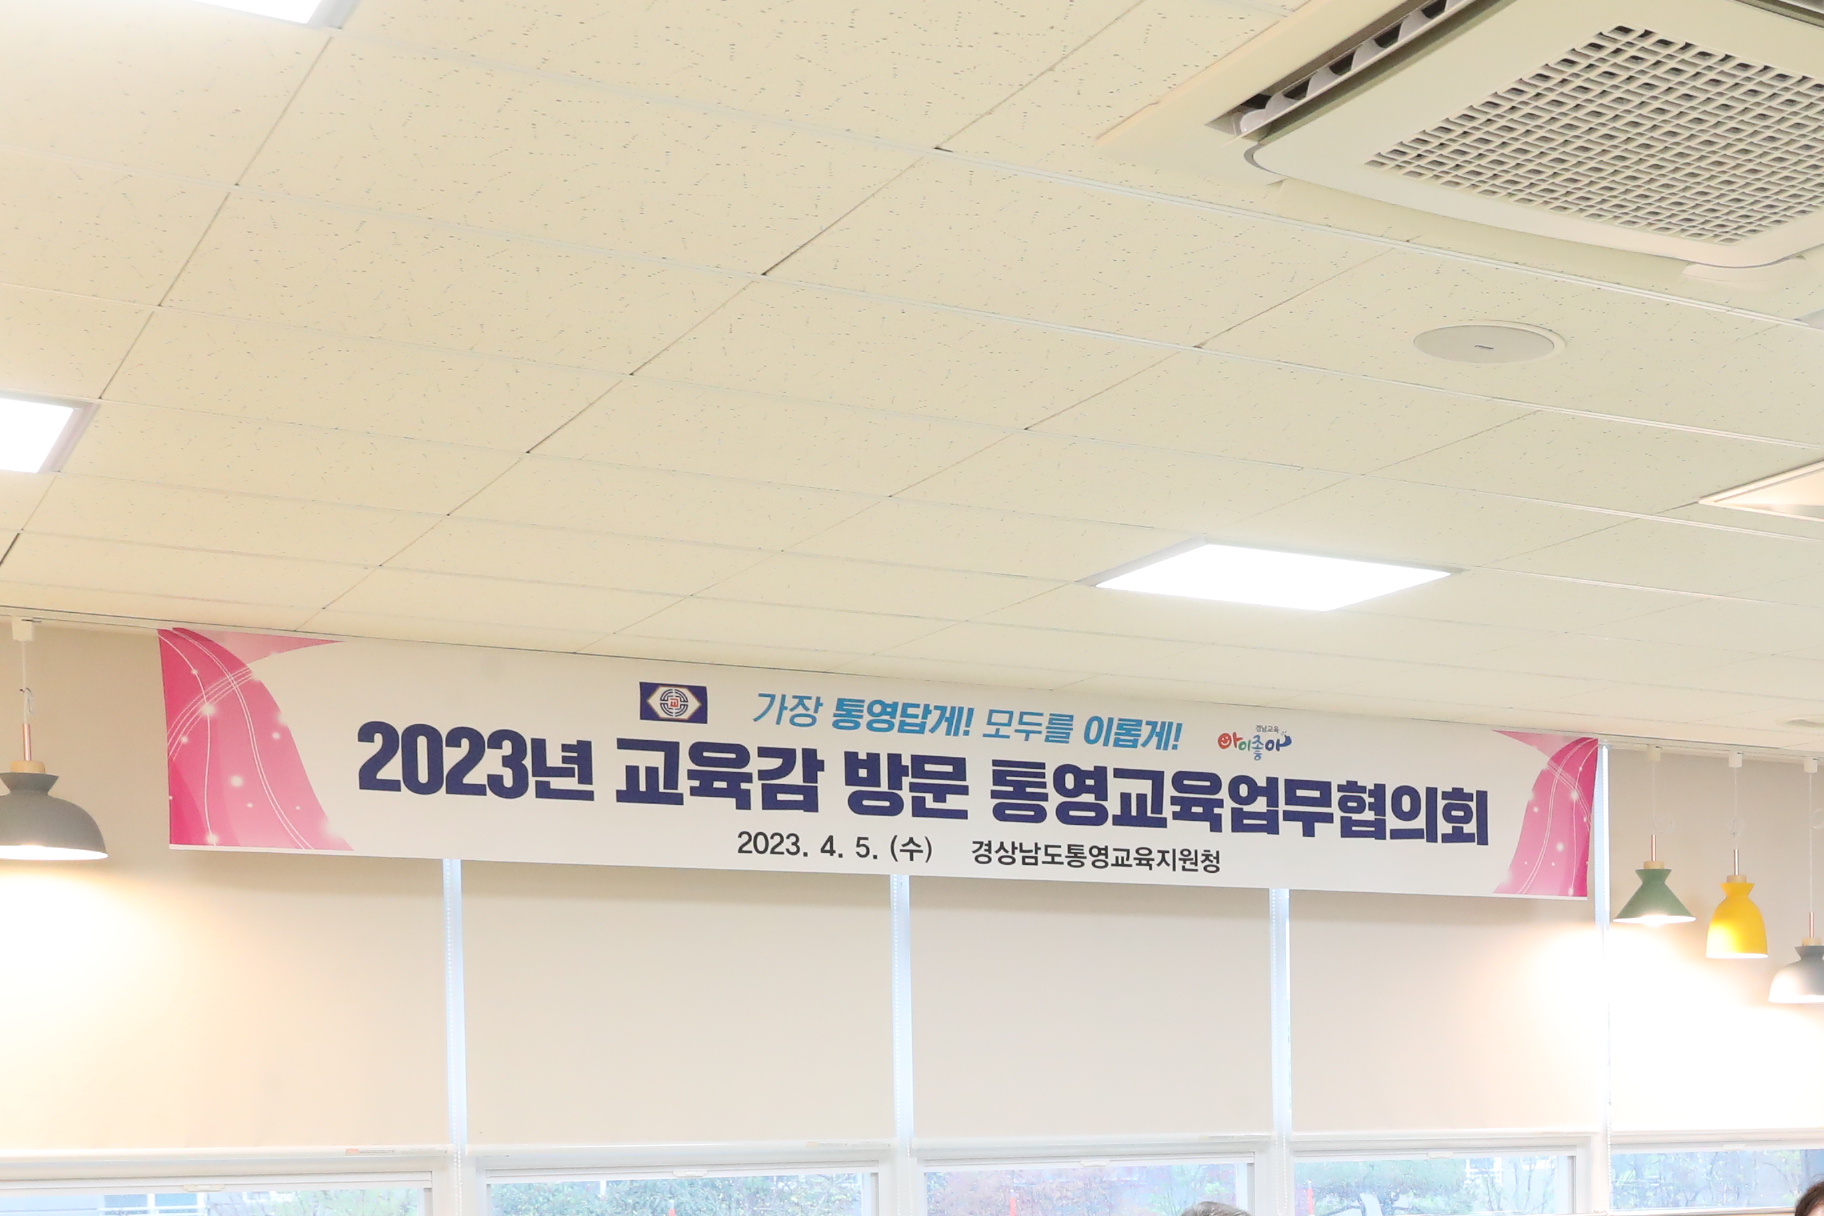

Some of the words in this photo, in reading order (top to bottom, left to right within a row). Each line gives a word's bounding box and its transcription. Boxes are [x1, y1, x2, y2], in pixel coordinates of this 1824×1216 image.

[753, 692, 824, 728] 가장
[831, 697, 975, 738] 통영답게!
[982, 708, 1076, 745] 모두를
[1083, 714, 1184, 752] 이롭게!
[1217, 731, 1292, 761] 아이좋아
[357, 720, 595, 803] 2023년
[615, 736, 825, 814] 교육감
[843, 749, 969, 821] 방문
[989, 753, 1489, 846] 통영교육업무협의회
[737, 830, 809, 859] 2023.
[820, 833, 844, 859] 4.
[855, 836, 879, 861] 5.
[889, 834, 933, 864] (수)
[971, 839, 1221, 875] 경상남도통영교육지원청
